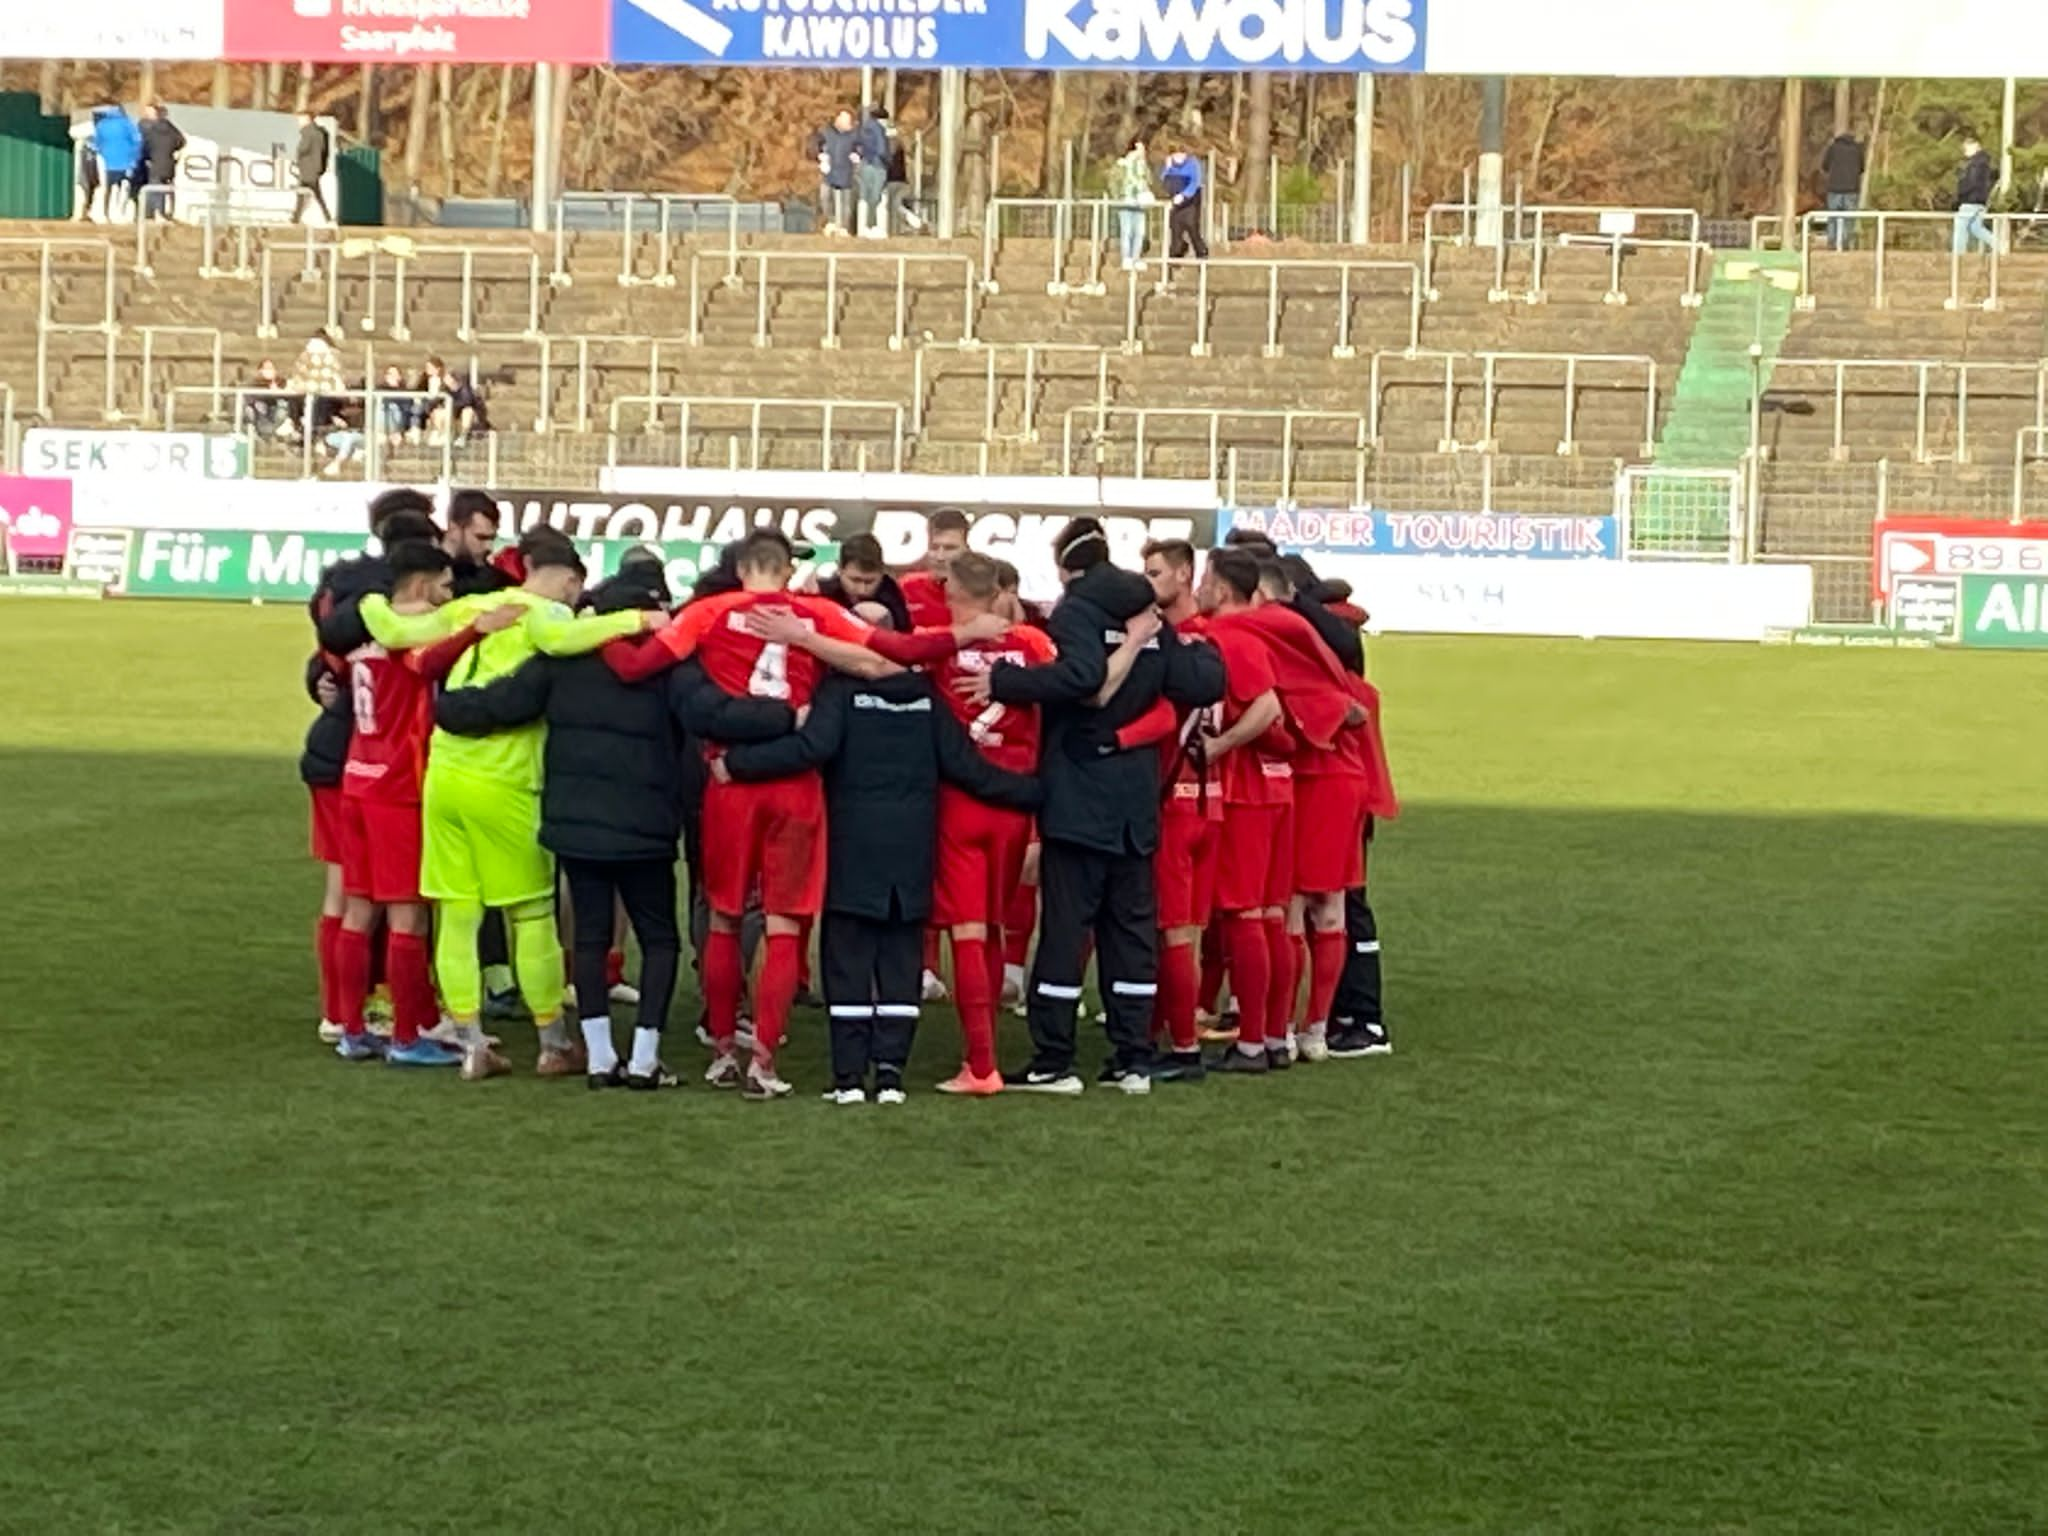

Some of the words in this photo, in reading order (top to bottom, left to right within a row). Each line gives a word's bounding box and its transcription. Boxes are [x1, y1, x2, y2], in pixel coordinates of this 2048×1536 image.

[762, 15, 939, 58] KAWOLUS
[39, 439, 191, 472] SEKTOR
[1386, 512, 1605, 551] TOURISTIK
[139, 531, 231, 582] Für
